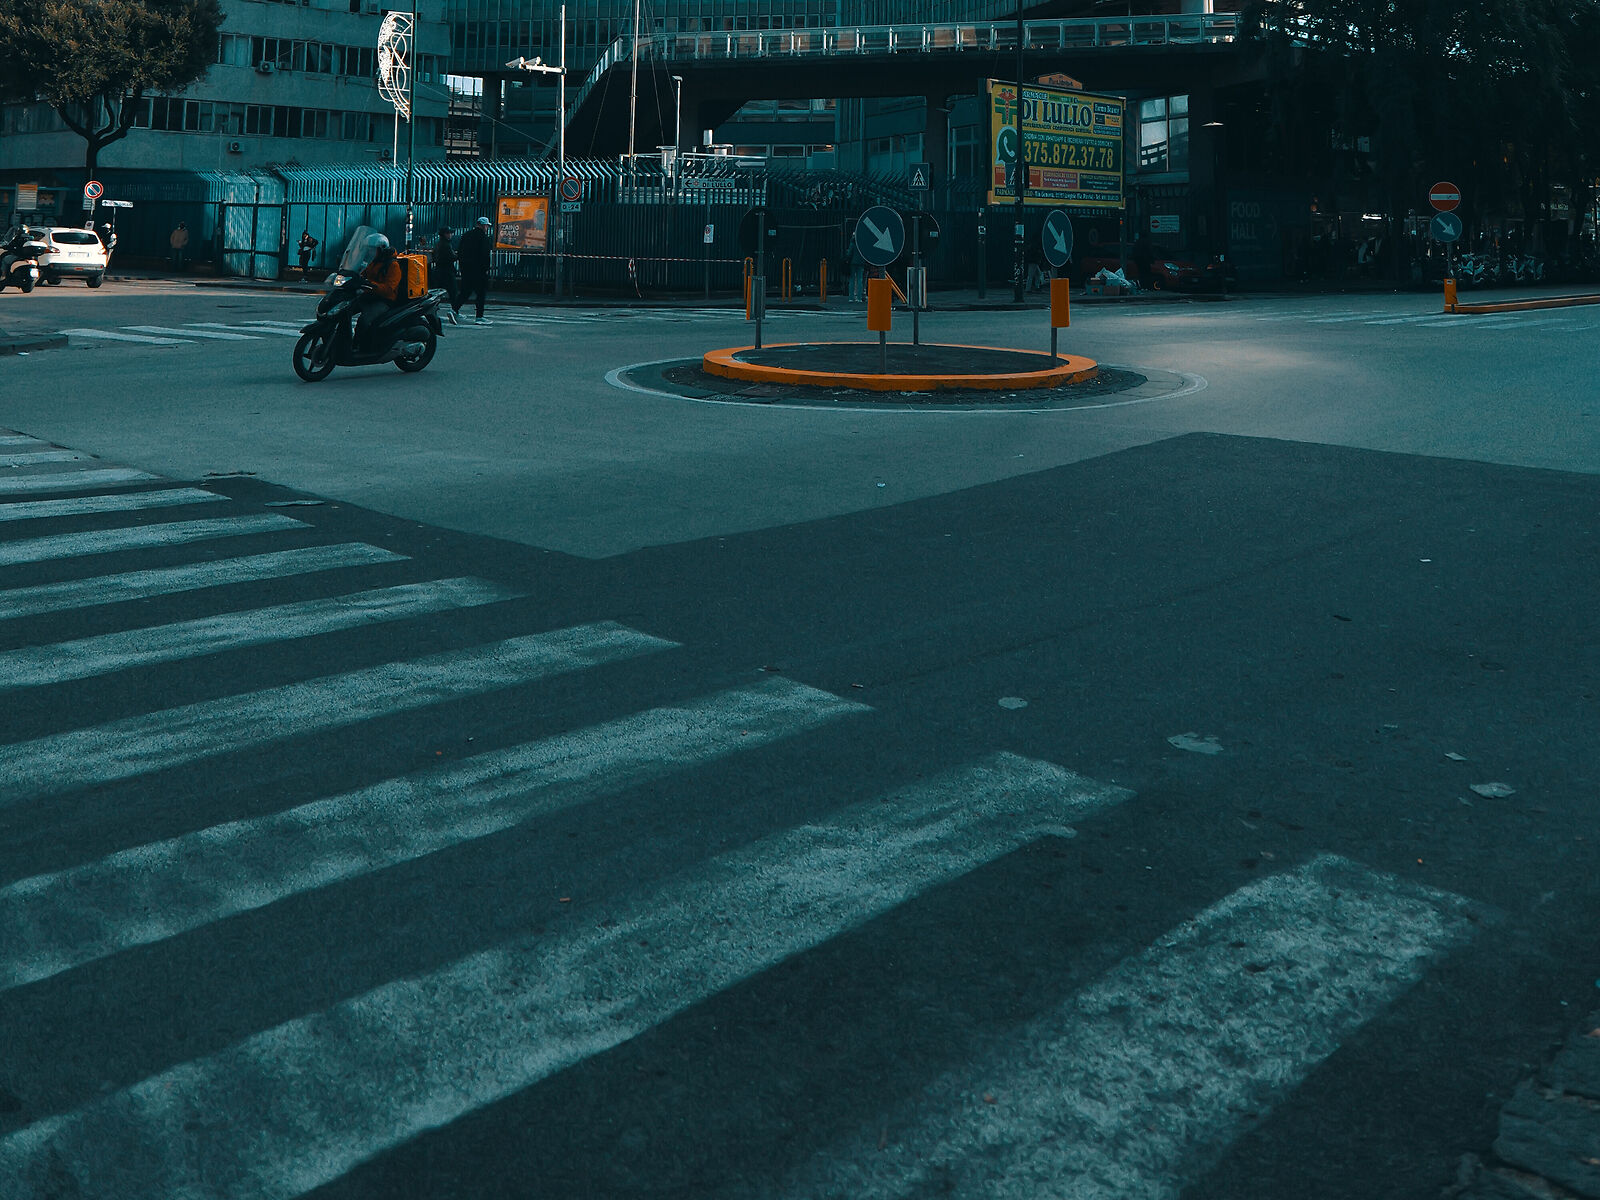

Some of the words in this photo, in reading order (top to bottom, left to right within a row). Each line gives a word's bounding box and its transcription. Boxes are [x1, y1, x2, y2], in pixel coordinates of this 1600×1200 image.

[1022, 99, 1038, 121] DI
[1042, 101, 1092, 127] LULLO
[1024, 140, 1114, 169] 375.872.37.78
[1231, 201, 1261, 218] FOOD
[1231, 222, 1257, 240] HALL
